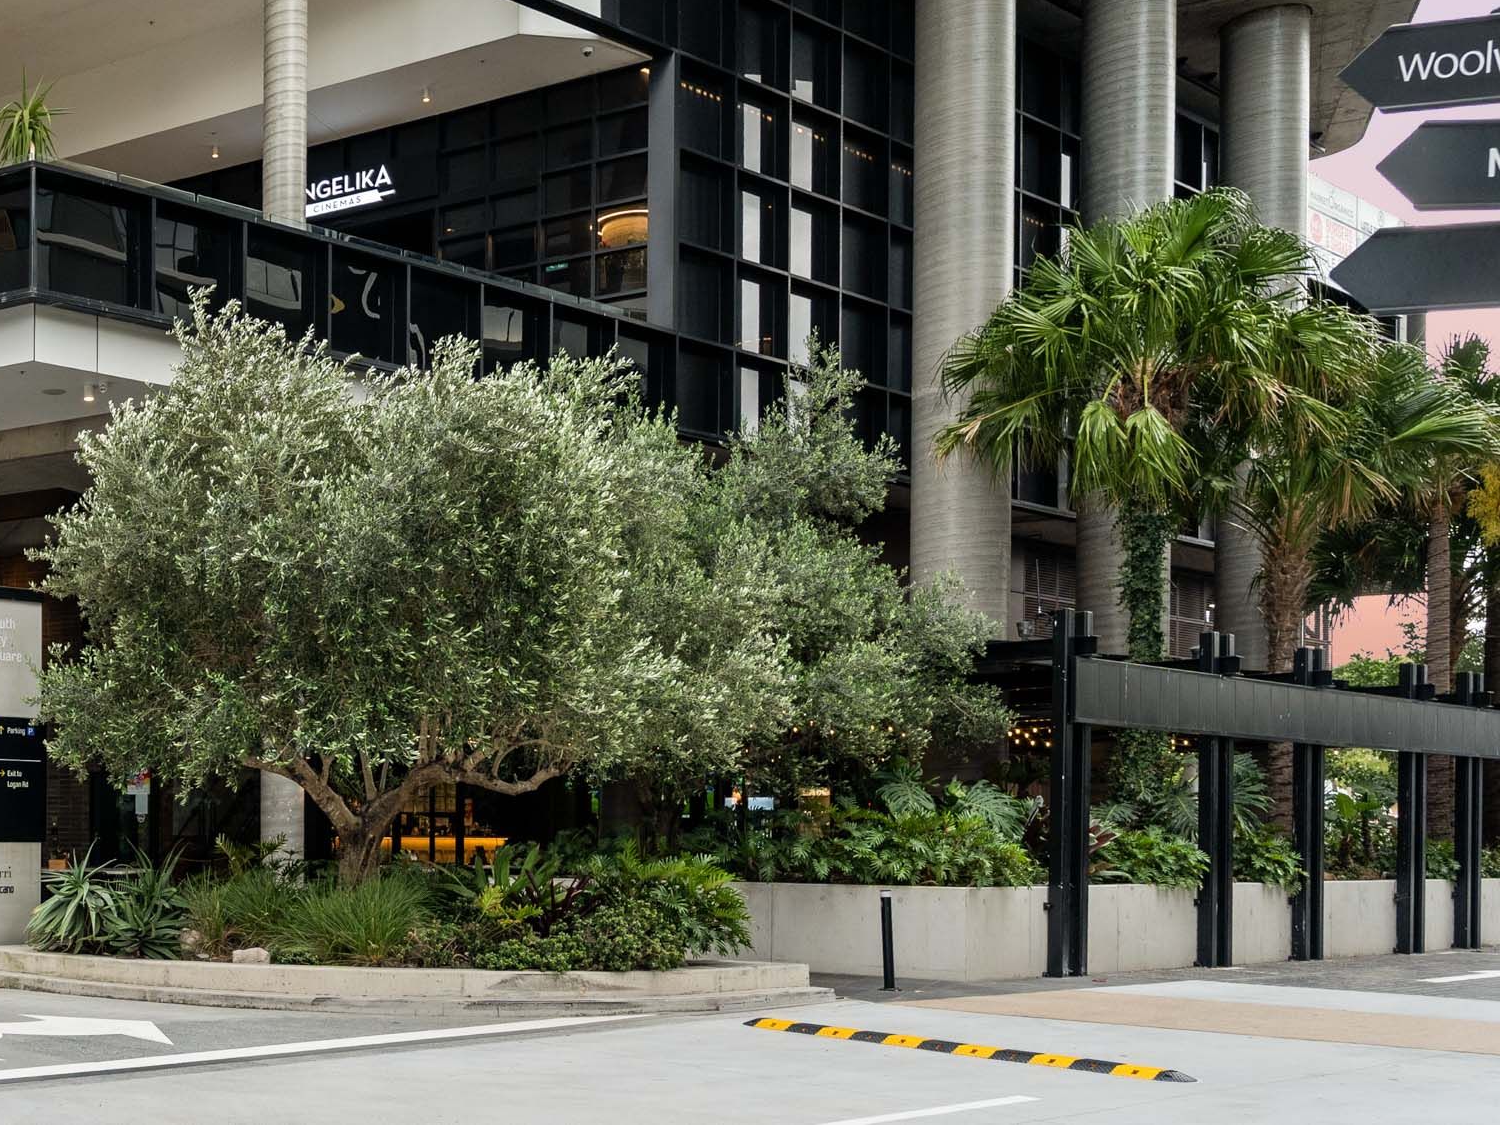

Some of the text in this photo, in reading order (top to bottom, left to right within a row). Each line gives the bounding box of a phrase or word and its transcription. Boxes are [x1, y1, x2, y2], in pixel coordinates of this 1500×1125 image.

[1398, 40, 1500, 82] Wool
[306, 163, 393, 201] NGELIKA
[313, 195, 362, 213] CINEMAS
[7, 726, 26, 736] Parking
[7, 769, 17, 777] Exit
[7, 780, 22, 789] Logan
